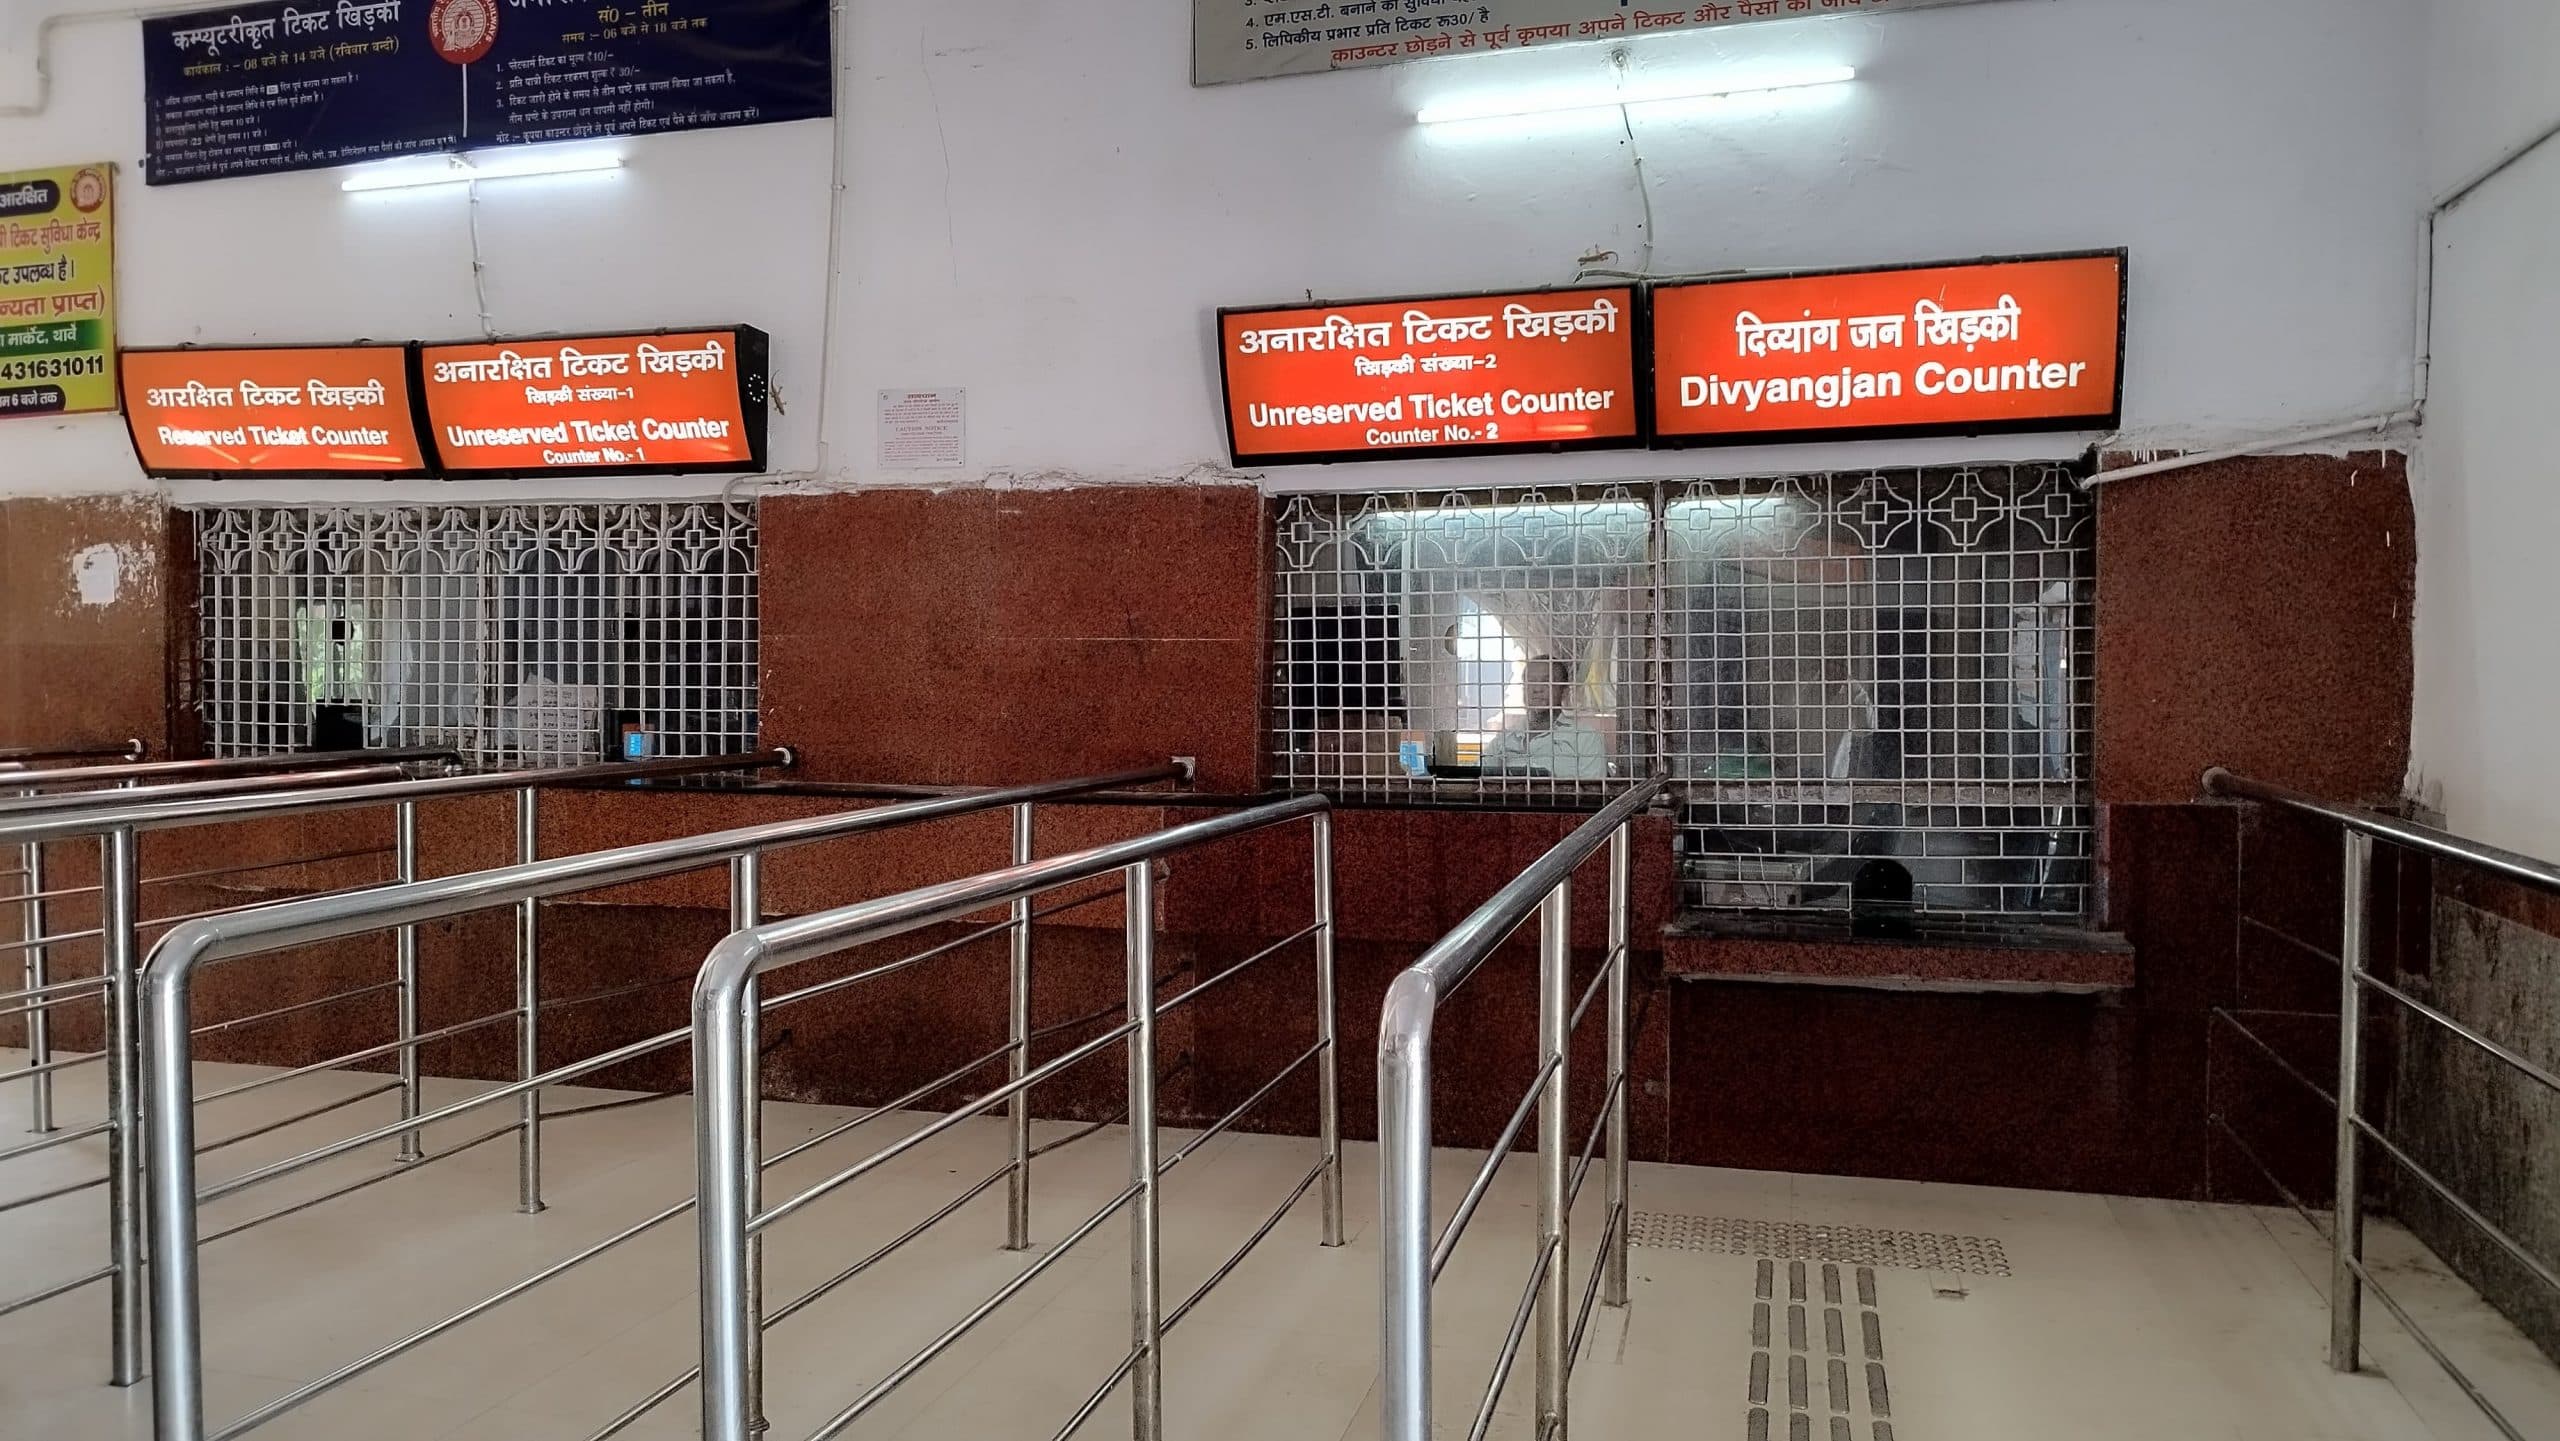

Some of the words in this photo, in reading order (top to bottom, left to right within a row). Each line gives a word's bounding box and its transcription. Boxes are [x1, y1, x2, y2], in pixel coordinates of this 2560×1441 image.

[172, 15, 276, 56] कम्प्यूटरीकृत
[282, 7, 330, 37] टिकट
[603, 28, 617, 39] 06
[1245, 39, 1258, 50] 5.
[1263, 29, 1321, 48] लिपिकीय
[1326, 25, 1361, 41] प्रभार
[1366, 19, 1390, 36] प्रति
[1395, 16, 1431, 33] टिकट
[1479, 6, 1490, 23] है
[1246, 17, 1259, 28] 4.
[1331, 41, 1399, 63] काउन्टर
[1405, 32, 1452, 56] छोड़ने
[1459, 29, 1477, 48] से
[1483, 24, 1511, 49] पूर्व
[1516, 23, 1571, 46] कृपया
[1578, 13, 1627, 35] अपने
[1634, 10, 1686, 30] टिकट
[1693, 4, 1732, 23] और
[244, 58, 257, 70] 08
[293, 52, 305, 64] 14
[10, 223, 38, 247] टिकट
[40, 218, 73, 254] सुविधा
[77, 217, 101, 243] केन्द्र
[13, 263, 54, 283] उपलब्ध
[58, 253, 67, 281] है
[52, 284, 105, 317] प्राप्त)
[1239, 314, 1394, 356] अनारक्षित
[1402, 310, 1494, 346] टिकट
[1502, 298, 1618, 343] खिड़की
[1735, 308, 1841, 357] दिव्यांग
[1848, 314, 1905, 350] जन
[1914, 294, 2021, 353] खिड़की
[433, 349, 553, 383] अनारक्षित
[560, 346, 630, 377] टिकट
[637, 340, 725, 378] खिड़की
[1354, 355, 1415, 379] खिड़की
[20, 390, 38, 406] बजे
[40, 391, 58, 405] तक
[147, 380, 234, 408] आरक्षित
[240, 379, 302, 406] टिकट
[307, 379, 385, 411] खिड़की
[525, 386, 573, 406] खिड़की
[1680, 366, 1901, 412] Divyangjan
[1914, 357, 2087, 396] Counter
[1248, 395, 1403, 428] Unreserved
[1408, 391, 1493, 421] Ticket
[1500, 387, 1614, 417] Counter
[157, 426, 246, 446] Reserved
[248, 426, 310, 446] Ticket
[311, 426, 389, 446] Counter
[447, 420, 568, 447] Unreserved
[570, 419, 638, 442] Ticket
[641, 417, 730, 440] Counter
[1365, 426, 1438, 446] Counter
[543, 449, 600, 465] Counter
